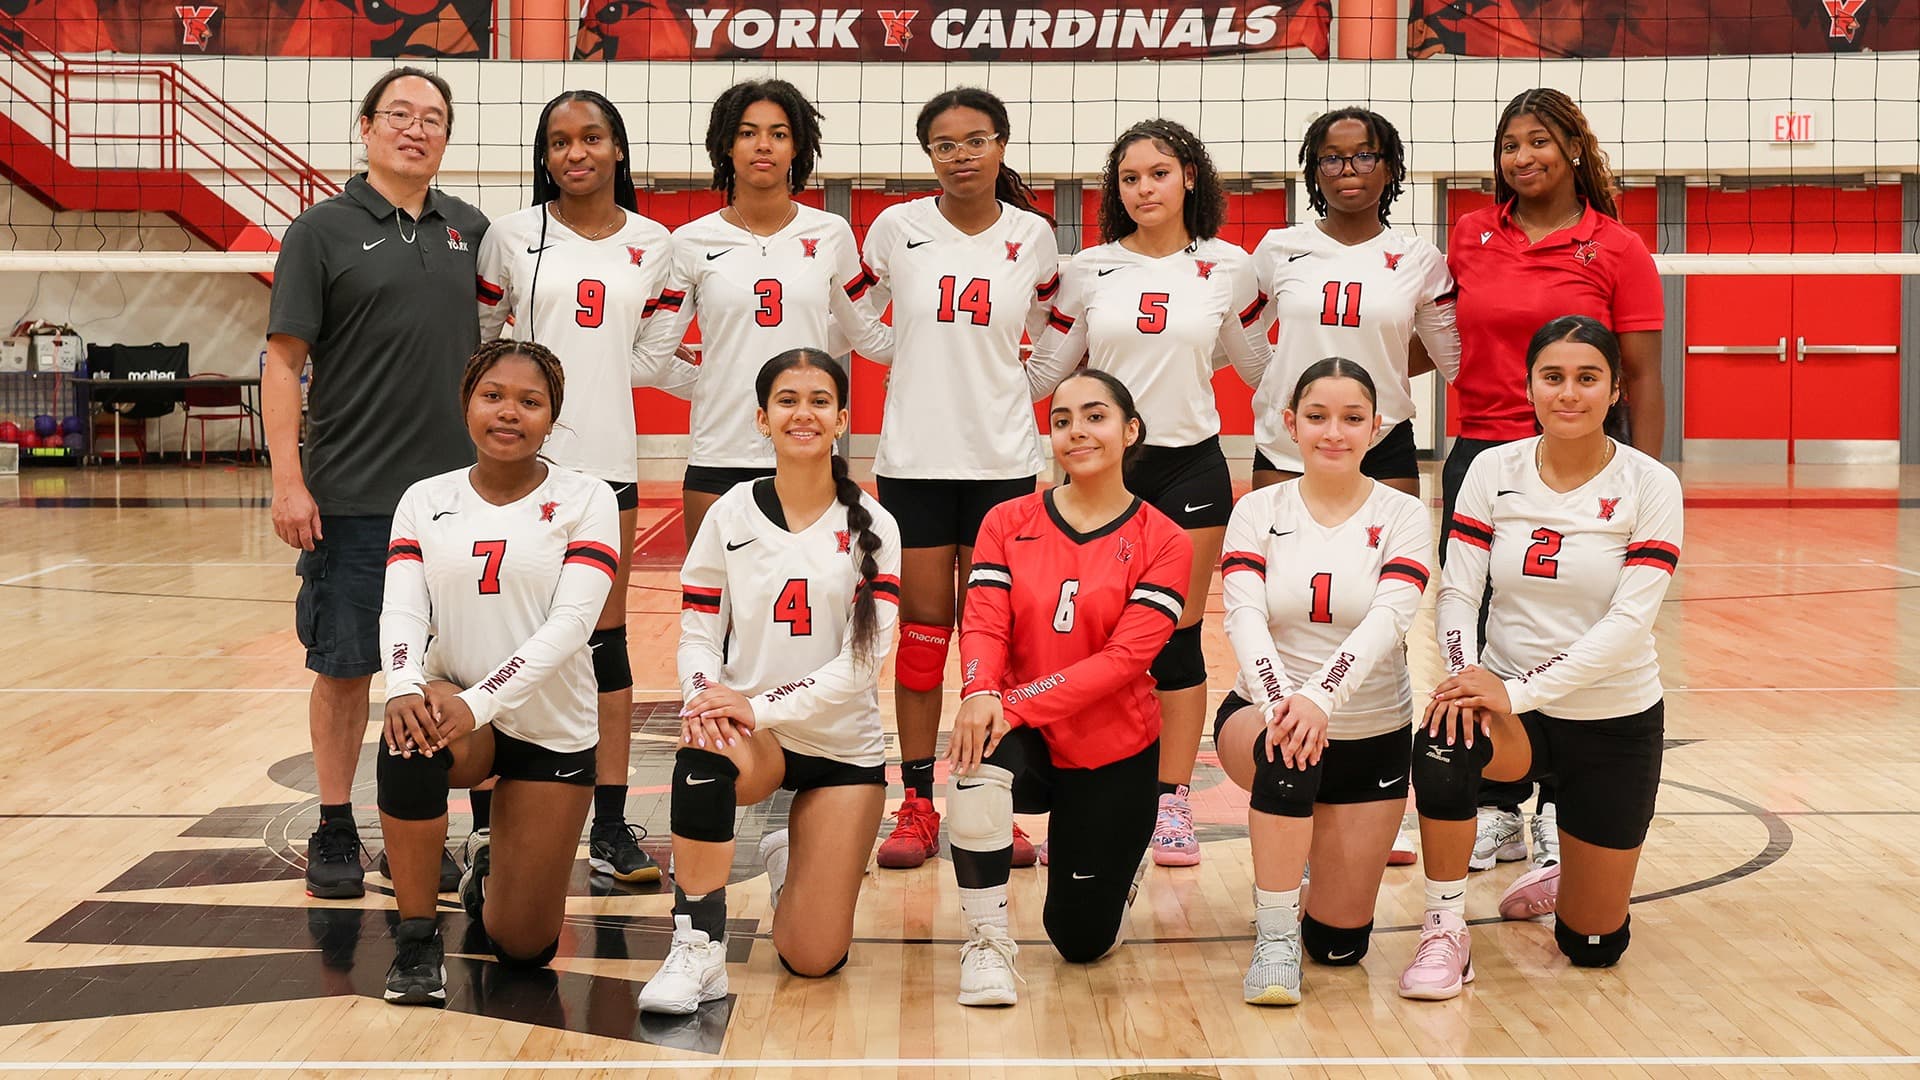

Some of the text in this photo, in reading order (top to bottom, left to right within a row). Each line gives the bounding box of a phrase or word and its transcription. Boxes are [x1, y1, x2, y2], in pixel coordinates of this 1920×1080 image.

[685, 9, 863, 49] YORK
[930, 5, 1282, 49] CARDINALS
[1775, 115, 1811, 140] EXIT
[575, 278, 606, 328] 9
[753, 278, 783, 327] 3
[937, 275, 991, 326] 14
[1136, 292, 1169, 334] 5
[1320, 281, 1362, 327] 11
[472, 539, 507, 595] 7
[1522, 527, 1564, 579] 2
[773, 578, 812, 636] 4
[1052, 578, 1080, 633] 6
[1309, 573, 1332, 623] 1
[908, 630, 946, 645] macron
